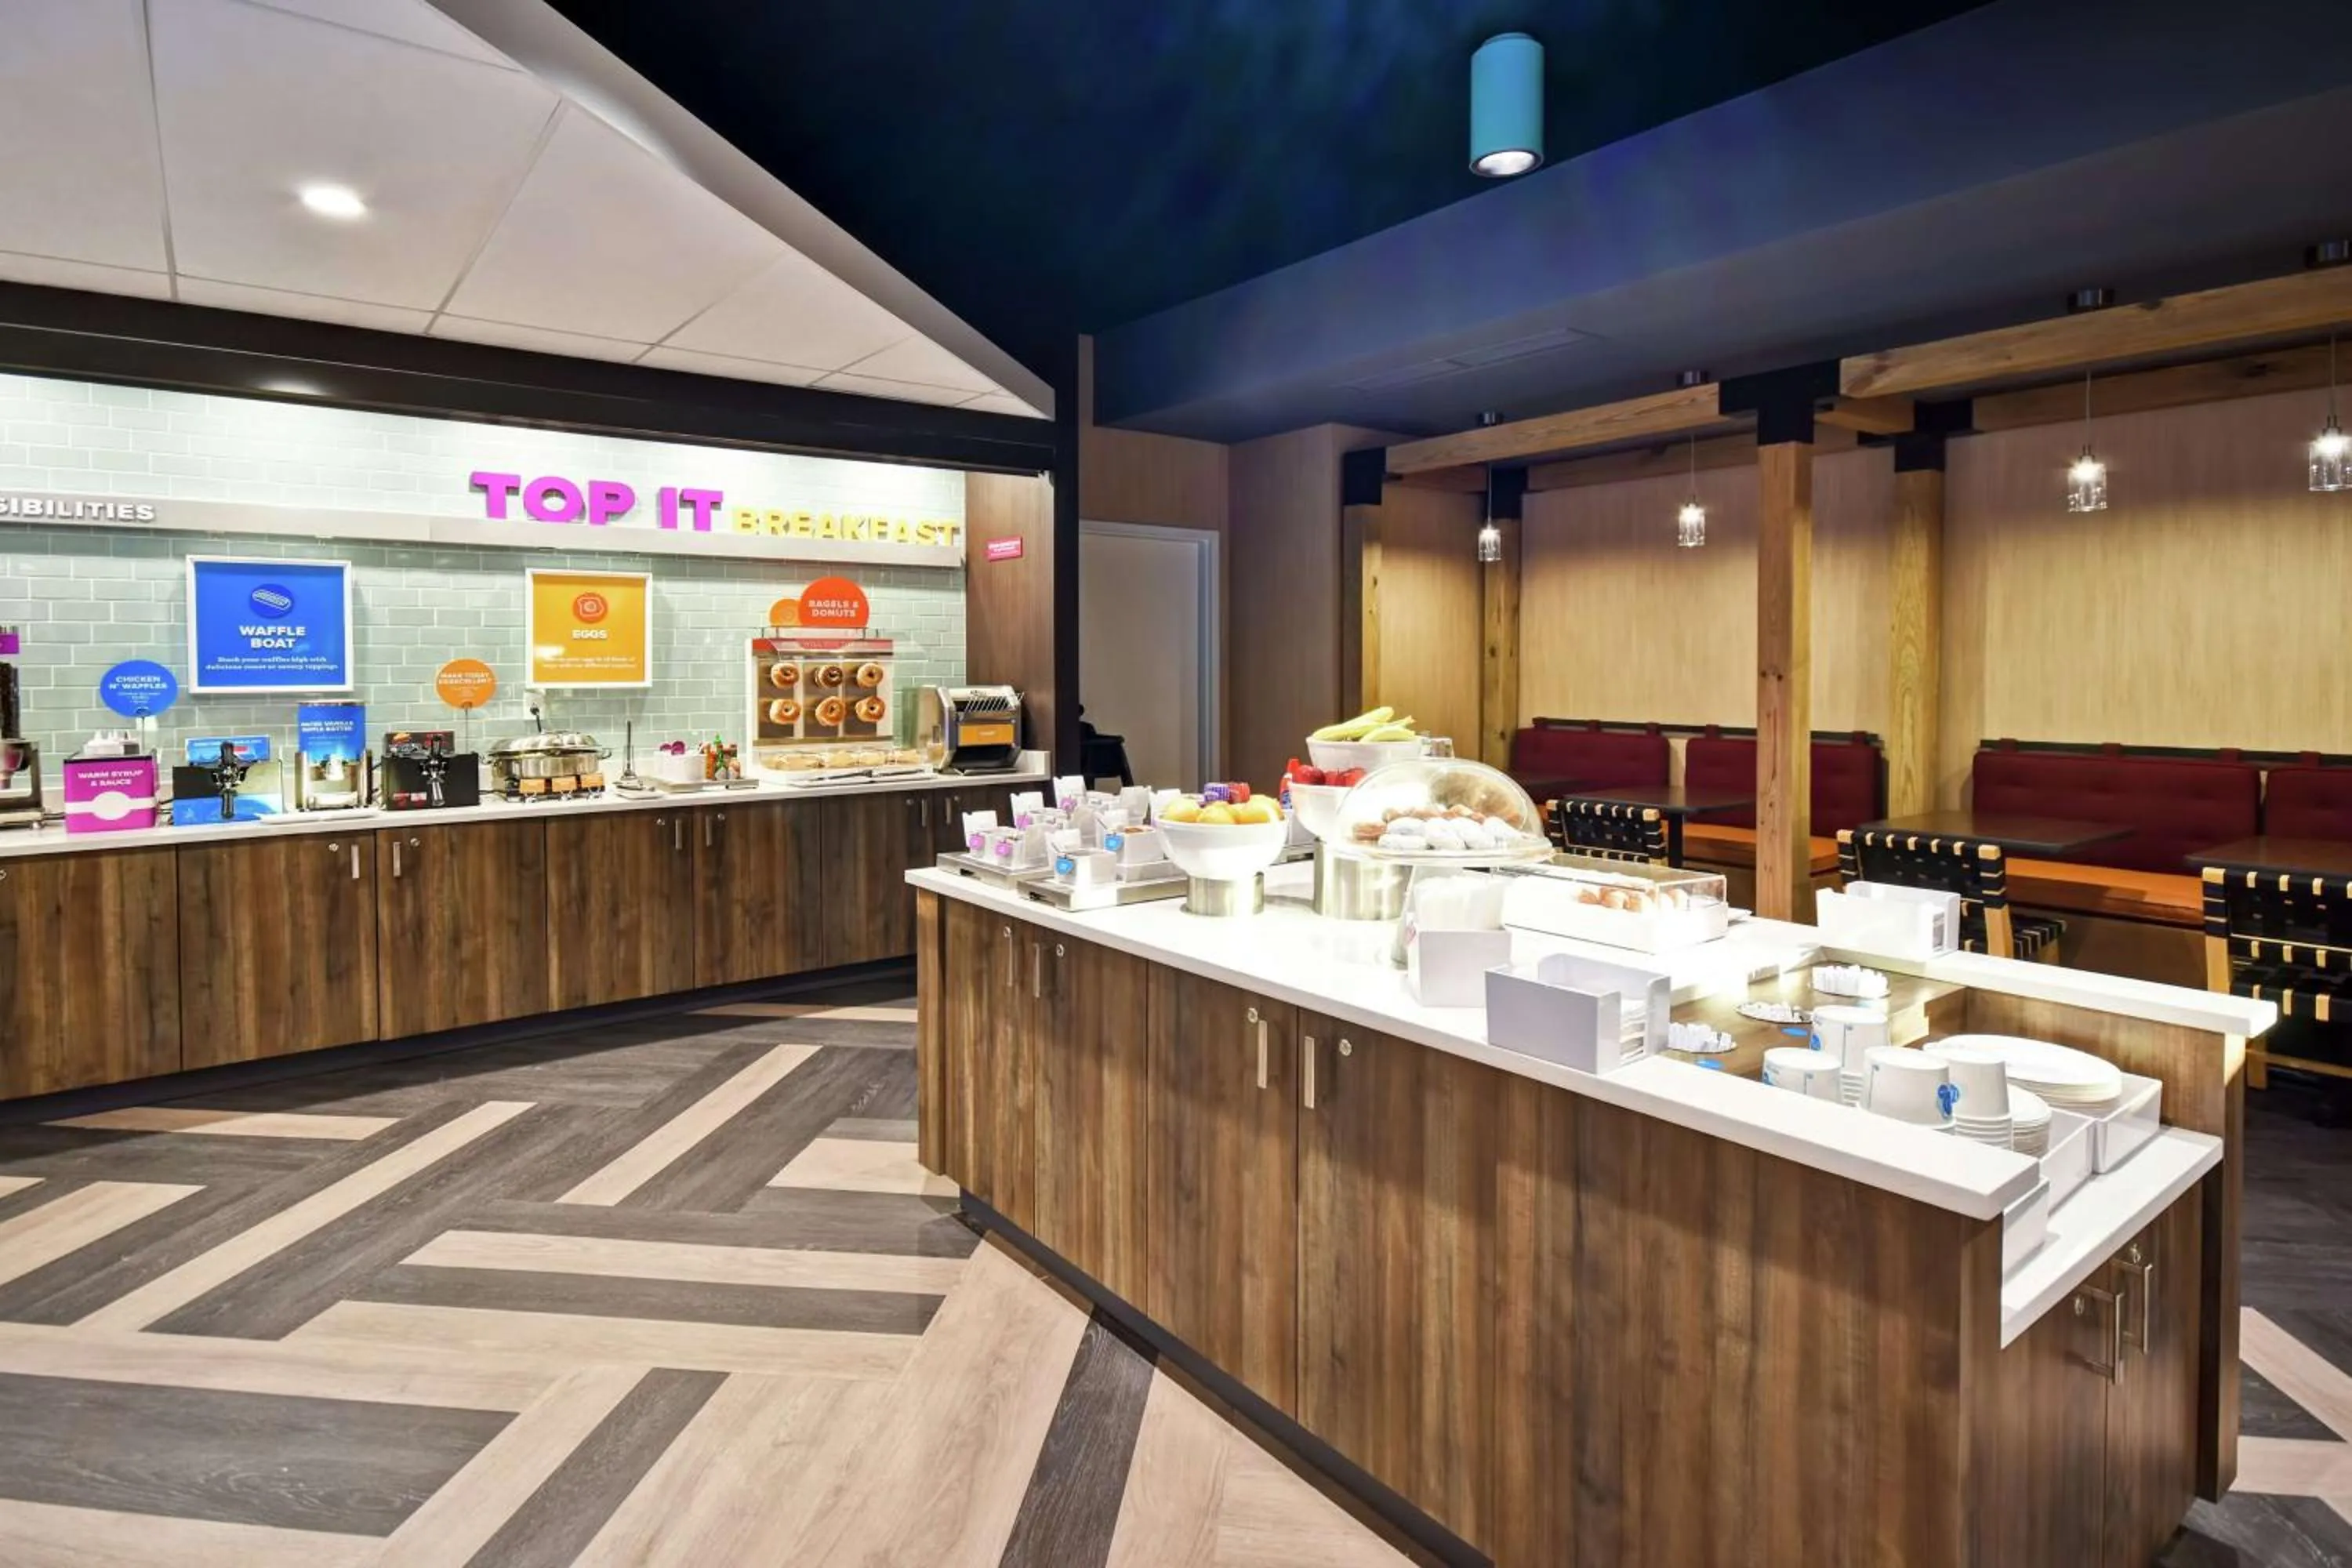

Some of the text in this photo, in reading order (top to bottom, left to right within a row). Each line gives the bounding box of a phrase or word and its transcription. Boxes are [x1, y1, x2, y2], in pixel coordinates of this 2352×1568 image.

[470, 471, 960, 546] TOP IT BREAKFAST
[808, 599, 850, 608] BAGELS
[811, 608, 856, 618] DONUTS
[238, 625, 306, 636] WAFFLE
[571, 629, 608, 640] EGGS
[250, 637, 296, 648] BOAT
